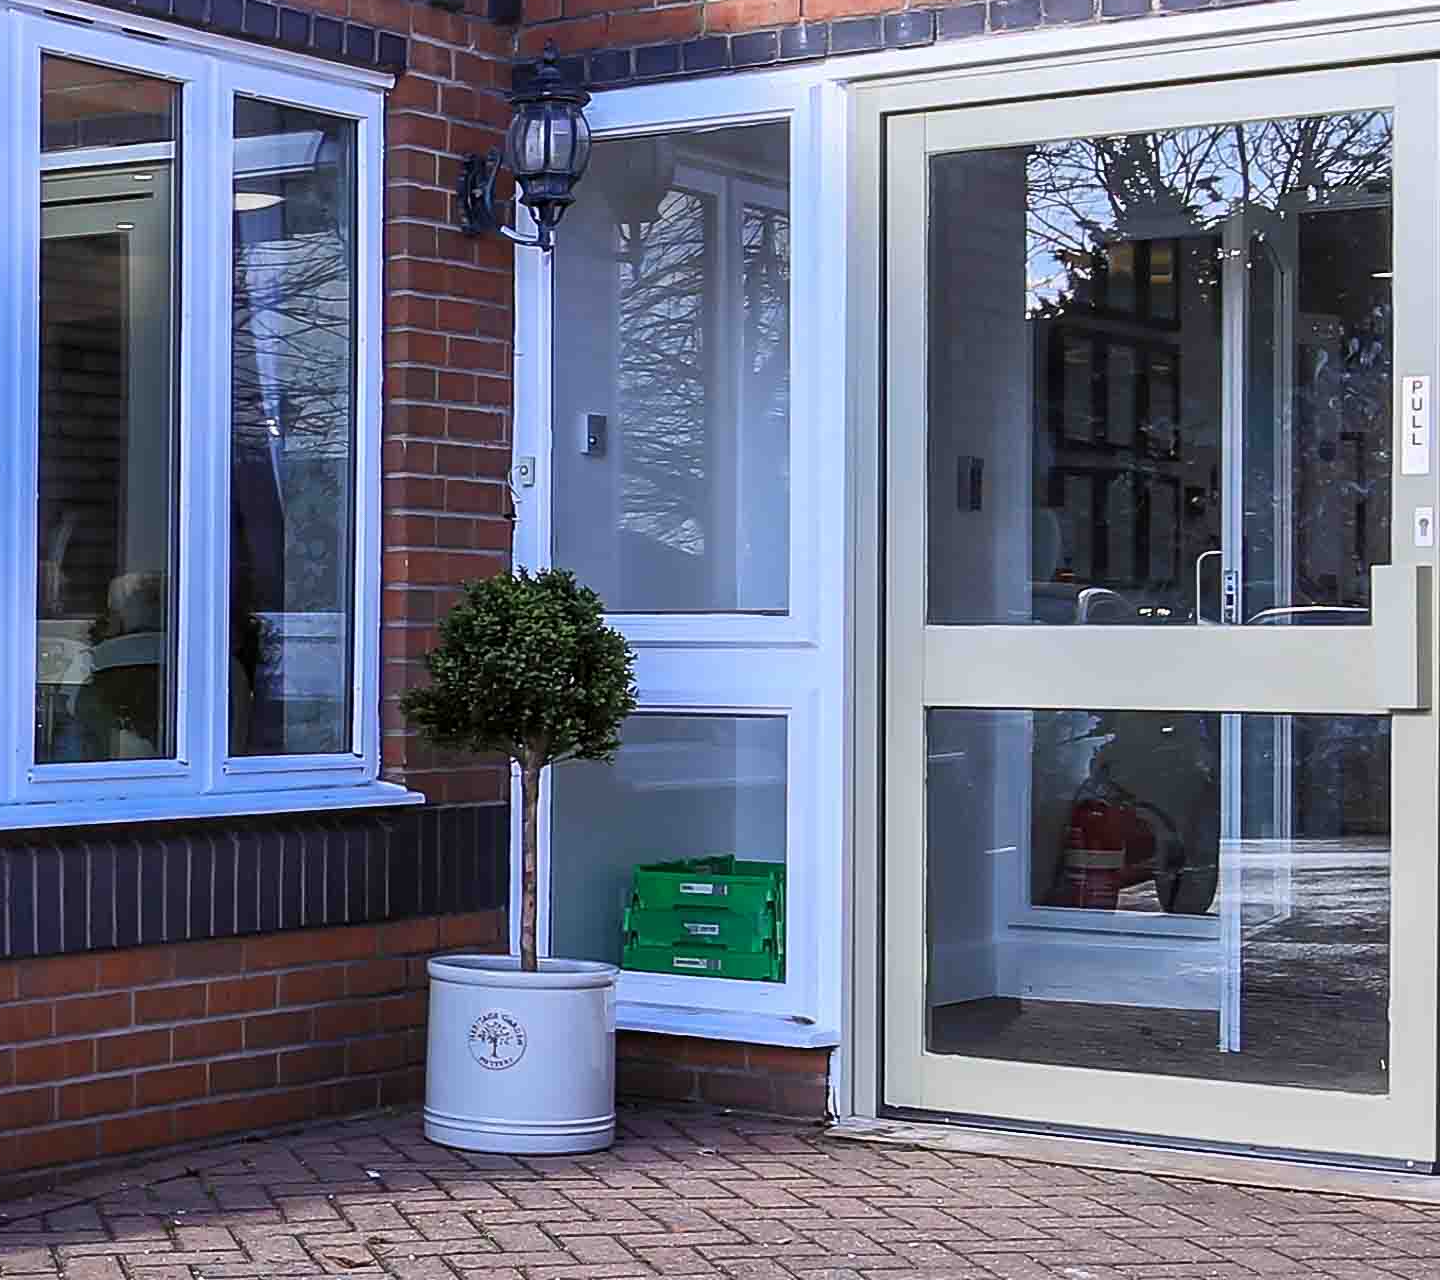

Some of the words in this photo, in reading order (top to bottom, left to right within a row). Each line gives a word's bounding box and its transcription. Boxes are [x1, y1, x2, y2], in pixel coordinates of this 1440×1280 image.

[1411, 380, 1423, 446] PULL
[501, 1014, 524, 1046] GARDEN
[479, 1056, 514, 1067] POTTERY
